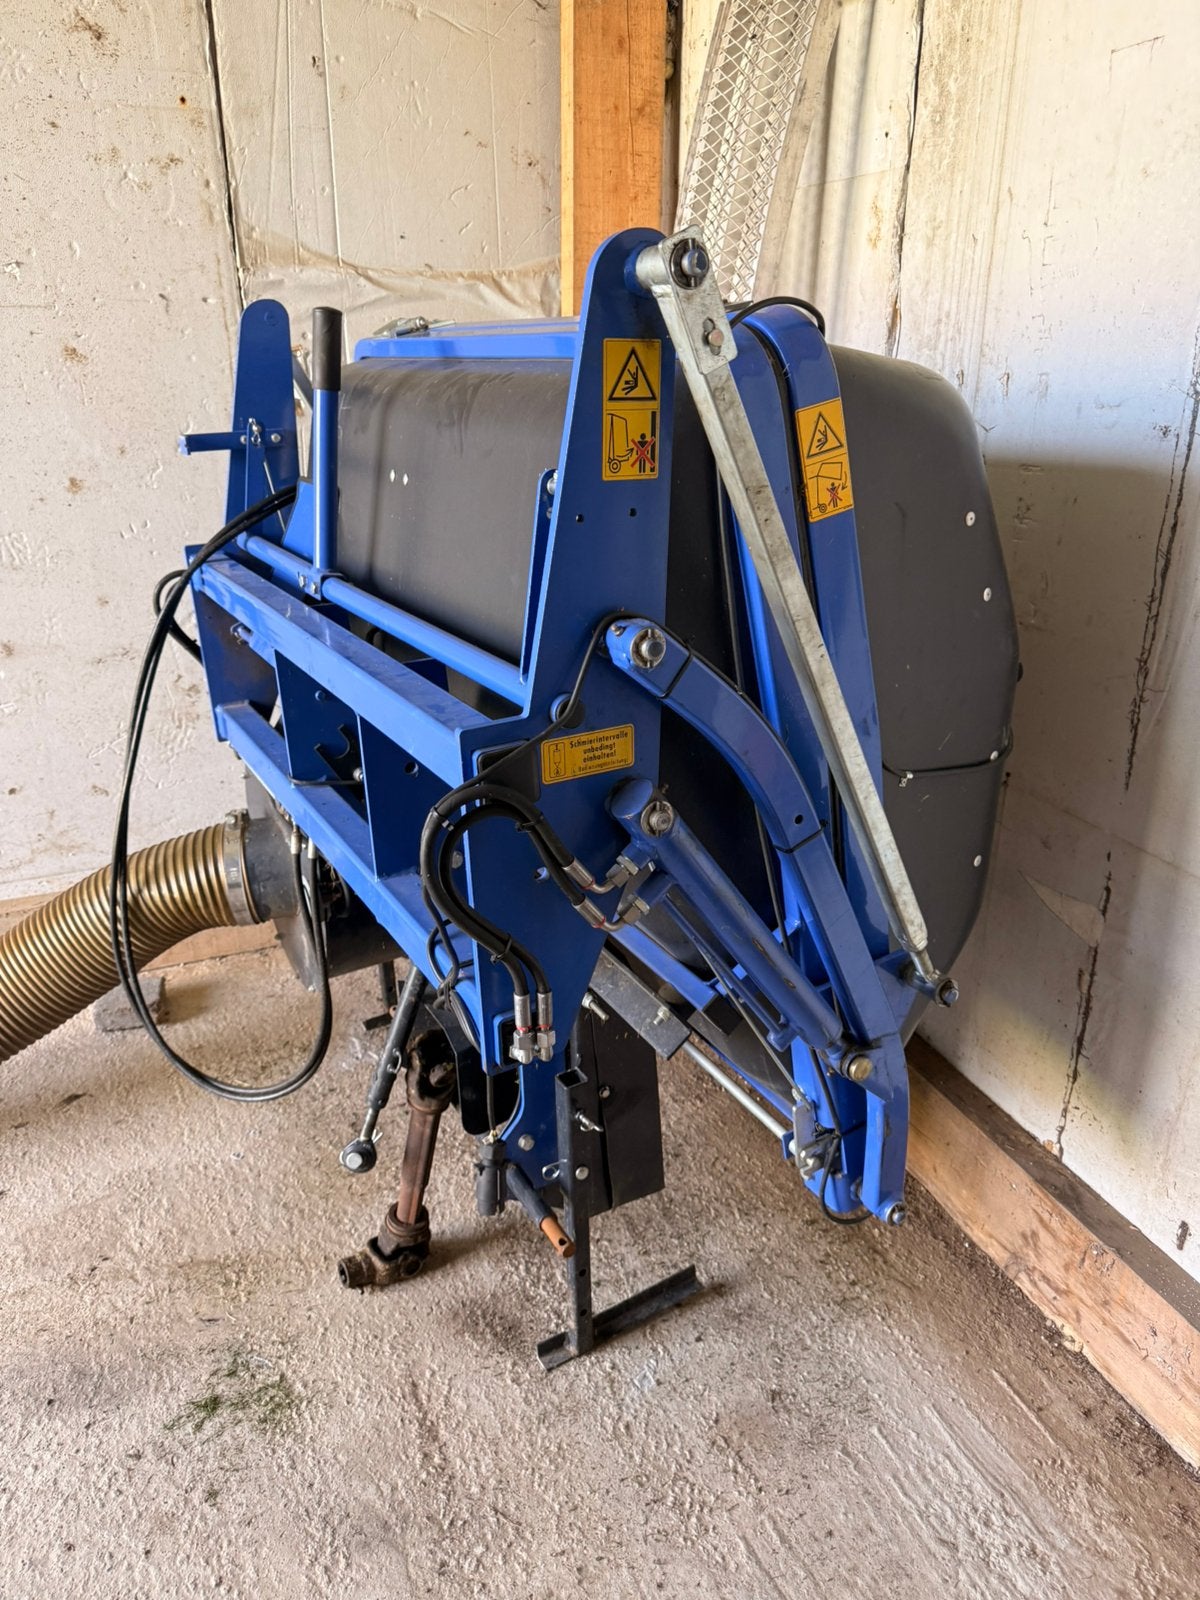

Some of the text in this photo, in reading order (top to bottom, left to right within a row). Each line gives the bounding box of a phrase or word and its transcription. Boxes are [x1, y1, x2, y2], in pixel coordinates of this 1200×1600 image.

[569, 730, 628, 749] Schmierintervalle
[583, 742, 616, 755] unbedingt
[583, 751, 617, 763] einhalten!
